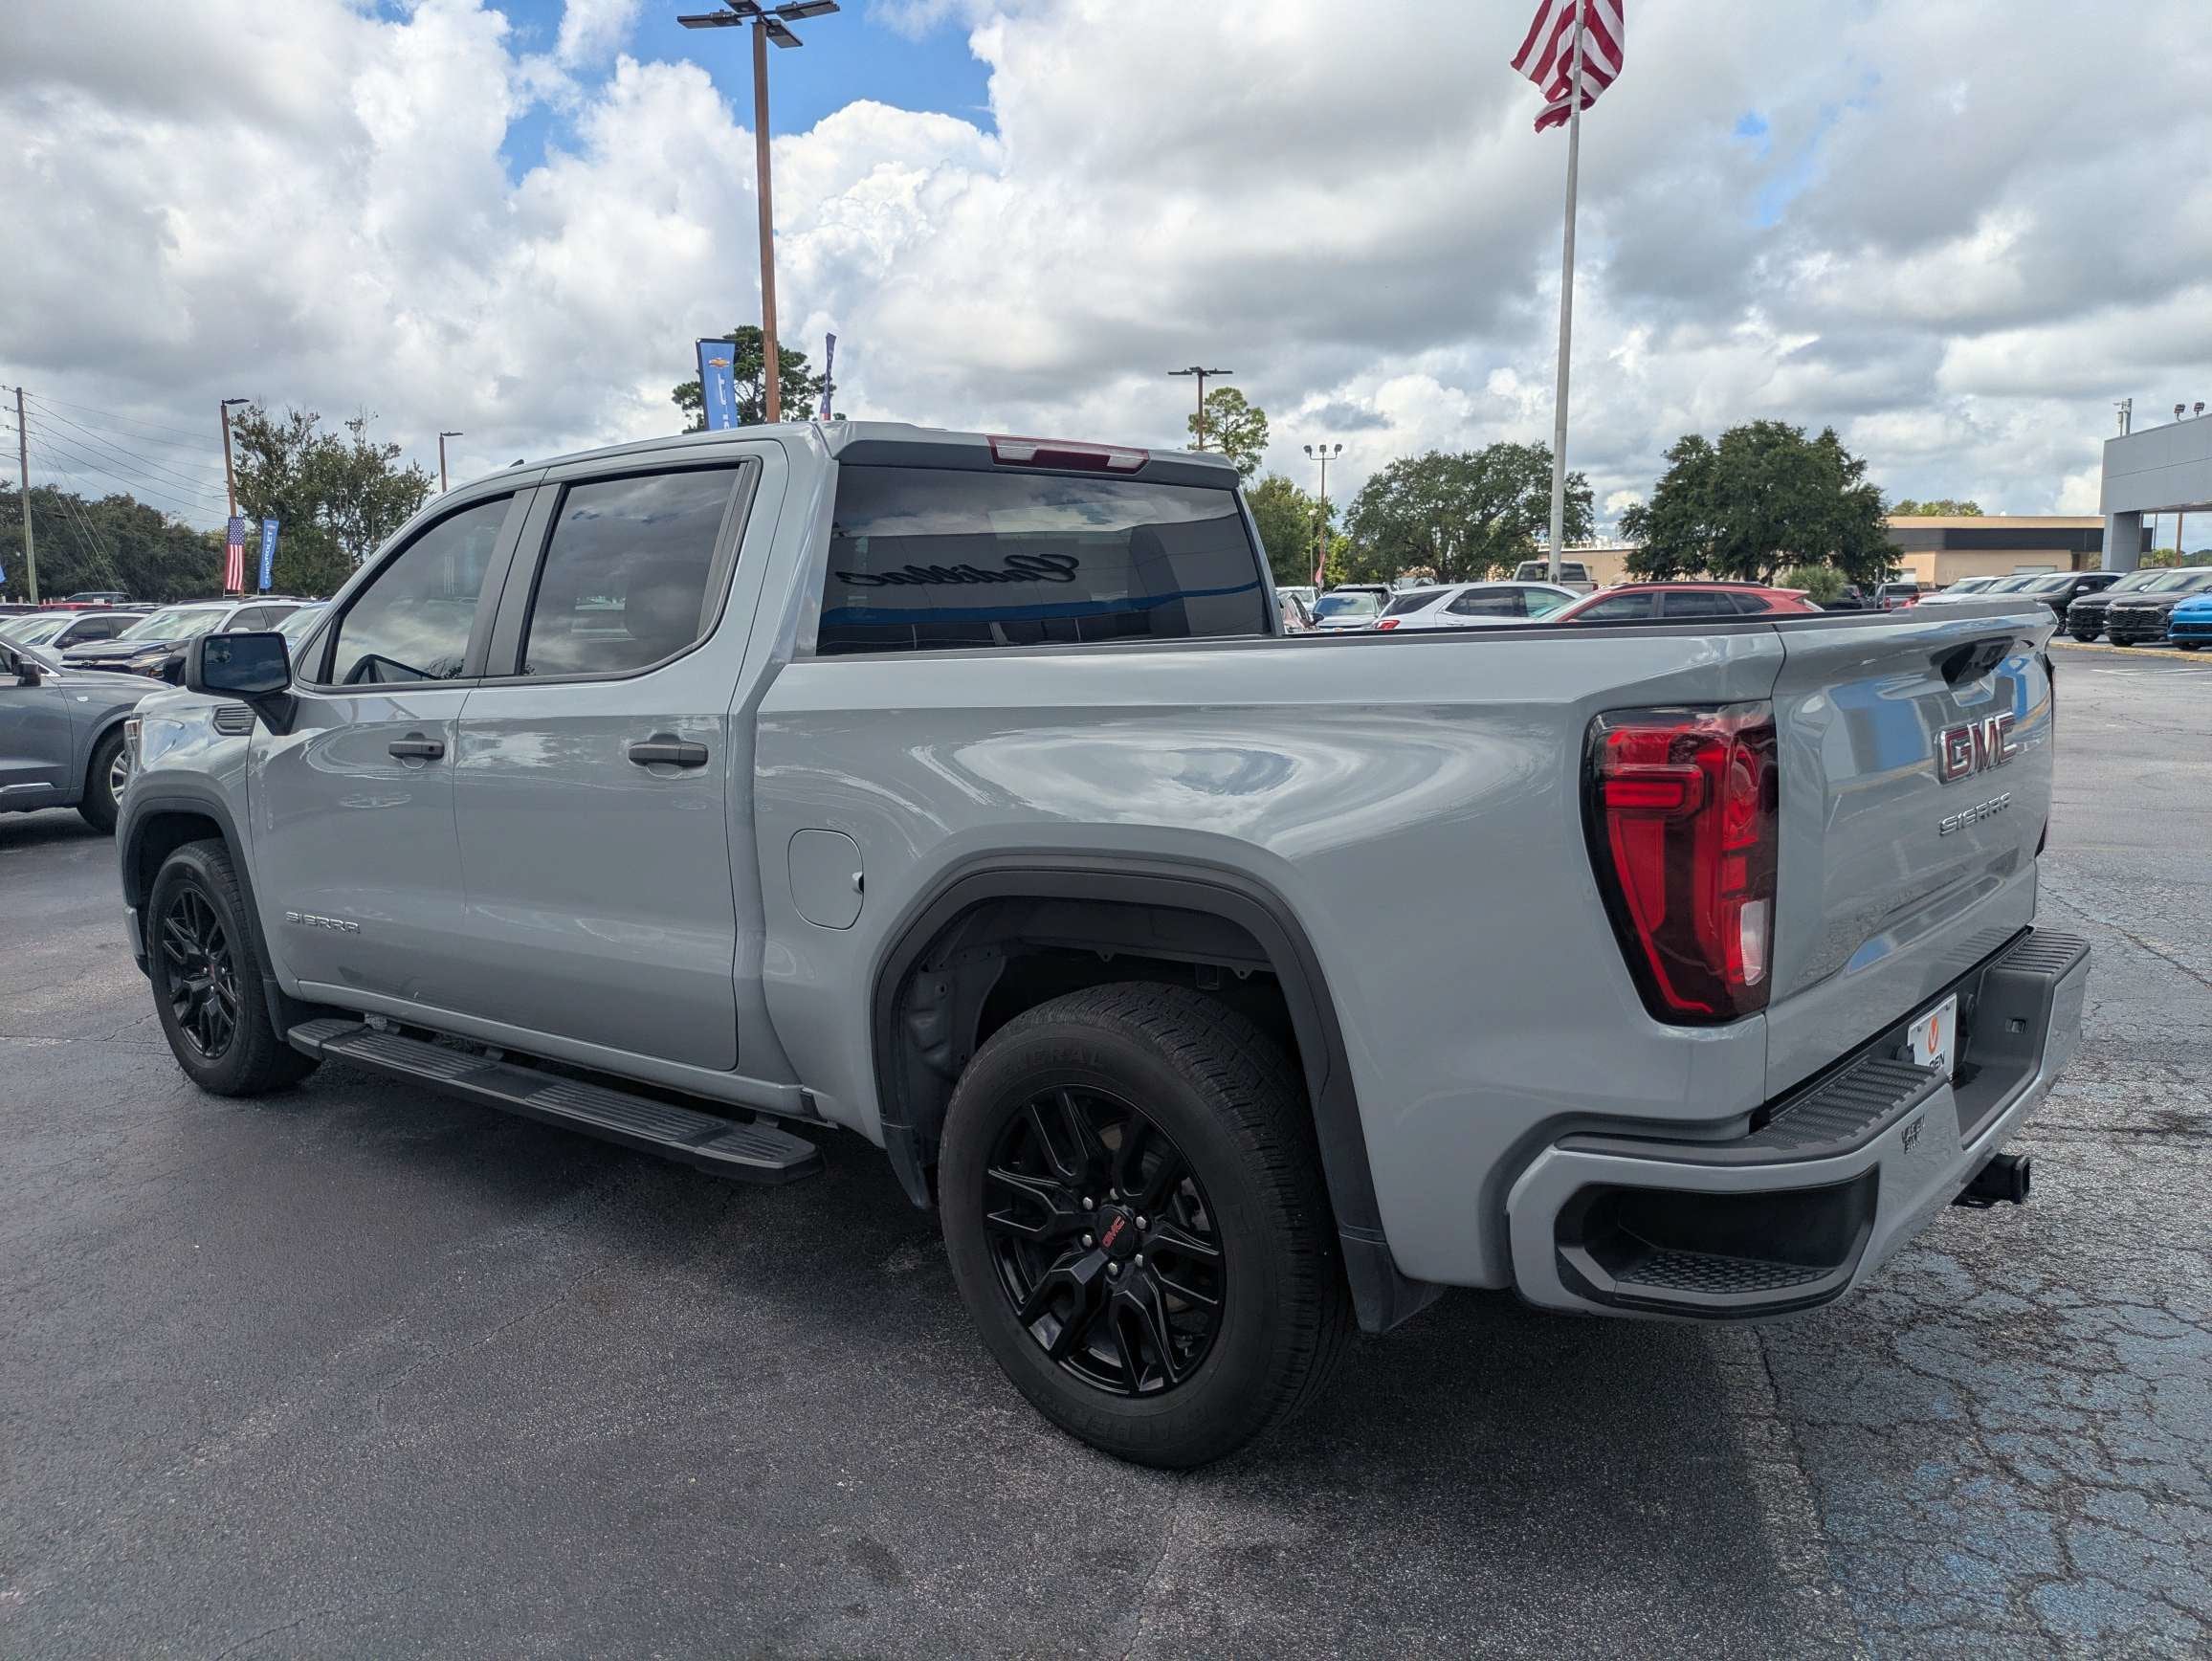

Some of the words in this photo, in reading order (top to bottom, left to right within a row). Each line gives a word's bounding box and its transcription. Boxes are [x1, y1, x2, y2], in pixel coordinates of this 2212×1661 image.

[1936, 711, 2019, 786] GMC
[1939, 791, 2012, 836] SIERRA
[285, 911, 362, 935] SIERRA
[1102, 1215, 1125, 1249] GMC
